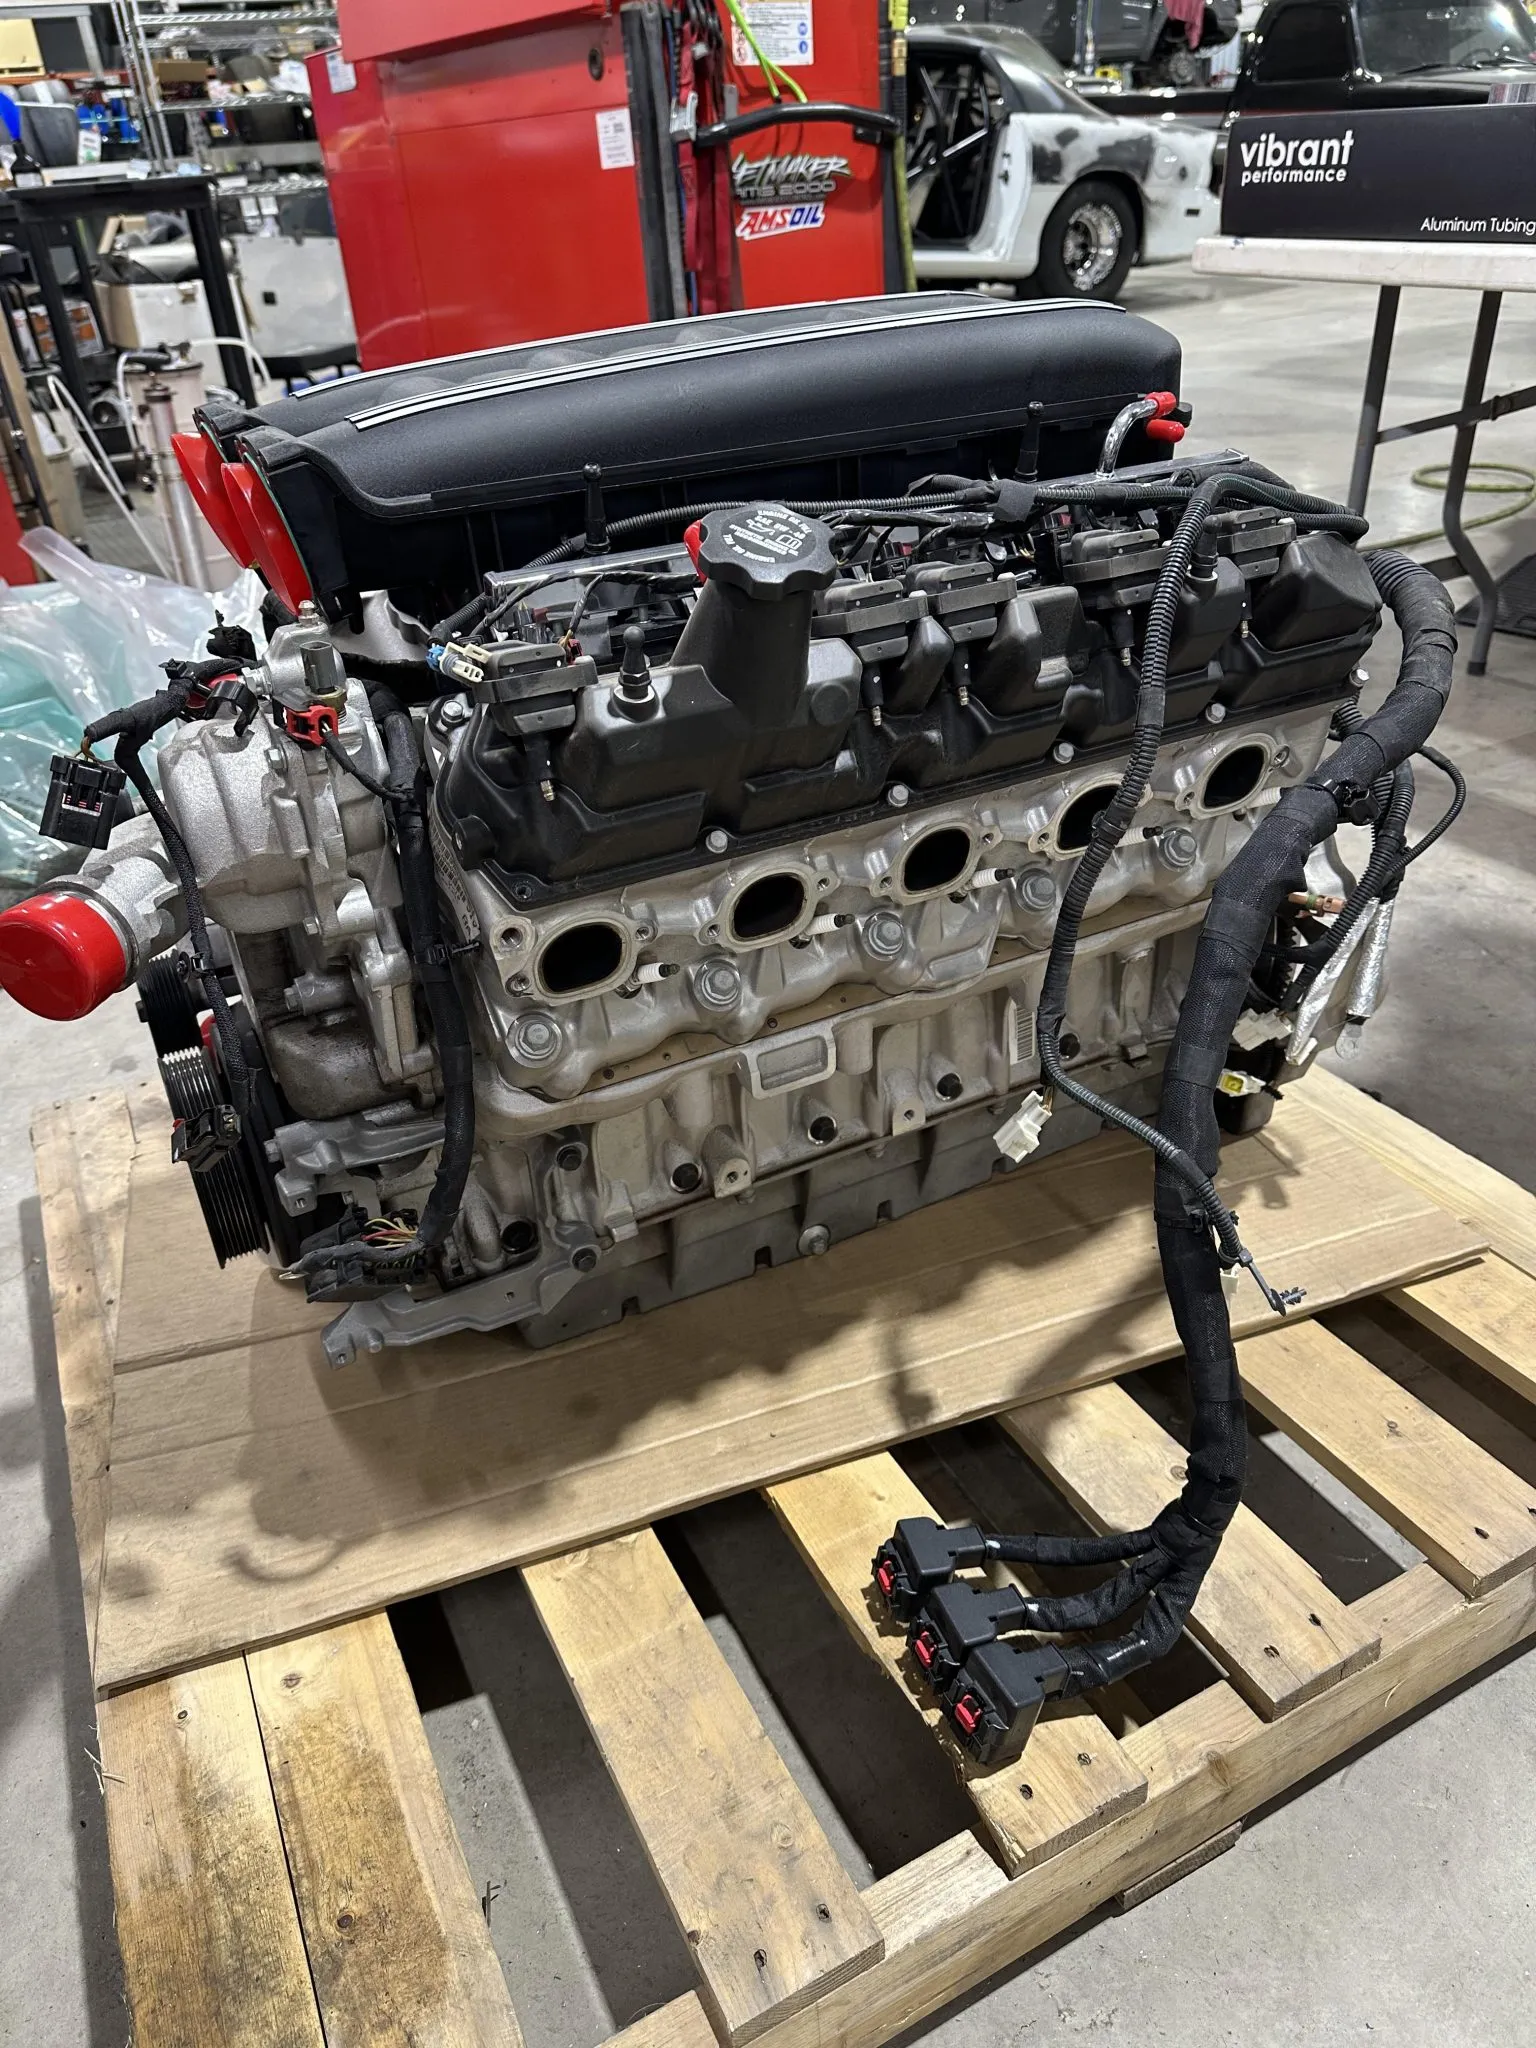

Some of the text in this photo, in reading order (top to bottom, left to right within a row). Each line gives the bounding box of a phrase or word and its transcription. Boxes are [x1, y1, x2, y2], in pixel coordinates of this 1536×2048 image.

[1240, 129, 1354, 168] vibrant
[1241, 167, 1347, 187] performance
[779, 180, 837, 196] 2000
[739, 204, 821, 235] AMSOIL
[1420, 216, 1536, 236] Aluminum Tubing
[754, 515, 773, 526] SAE
